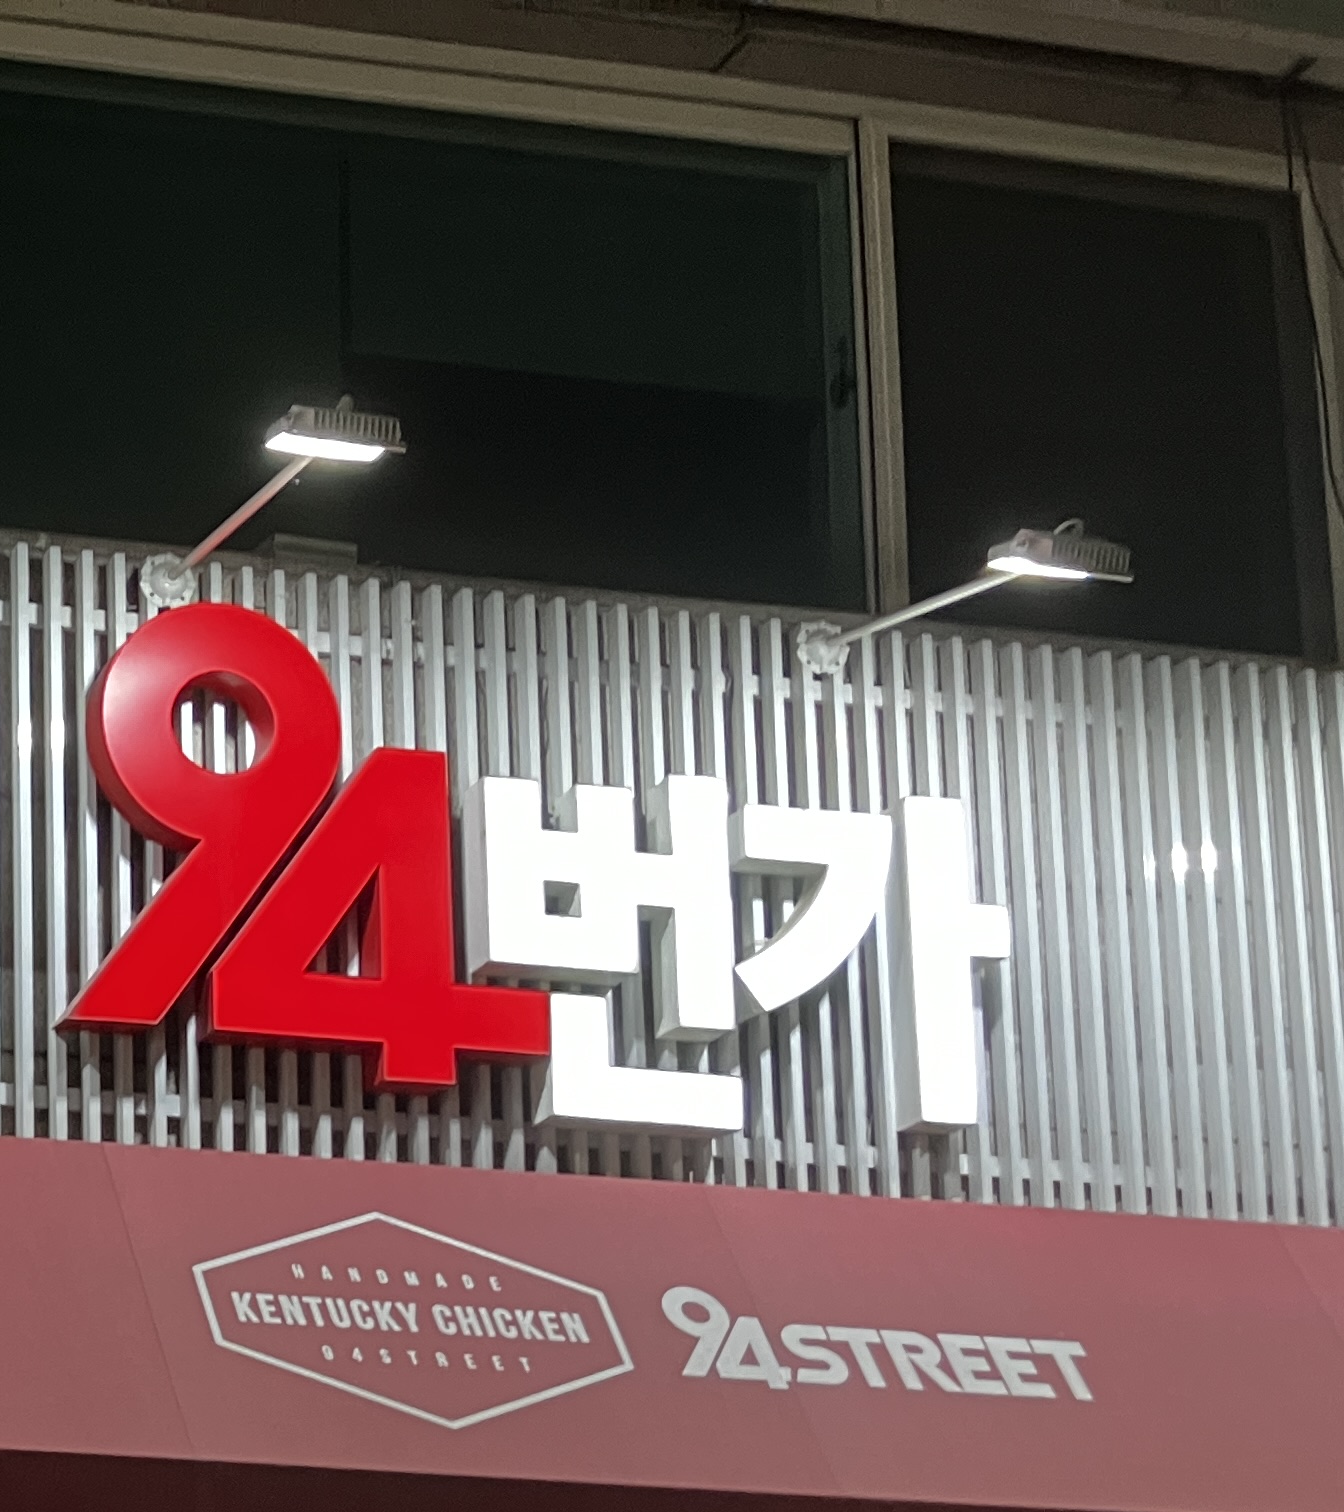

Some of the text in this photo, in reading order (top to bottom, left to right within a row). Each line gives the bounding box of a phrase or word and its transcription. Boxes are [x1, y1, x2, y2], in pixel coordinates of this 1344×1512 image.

[55, 601, 1010, 1133] 94번가
[230, 1290, 591, 1344] KENTUCKY CHICKEN
[292, 1263, 502, 1292] HANDMADE
[661, 1285, 1094, 1402] 94STREET
